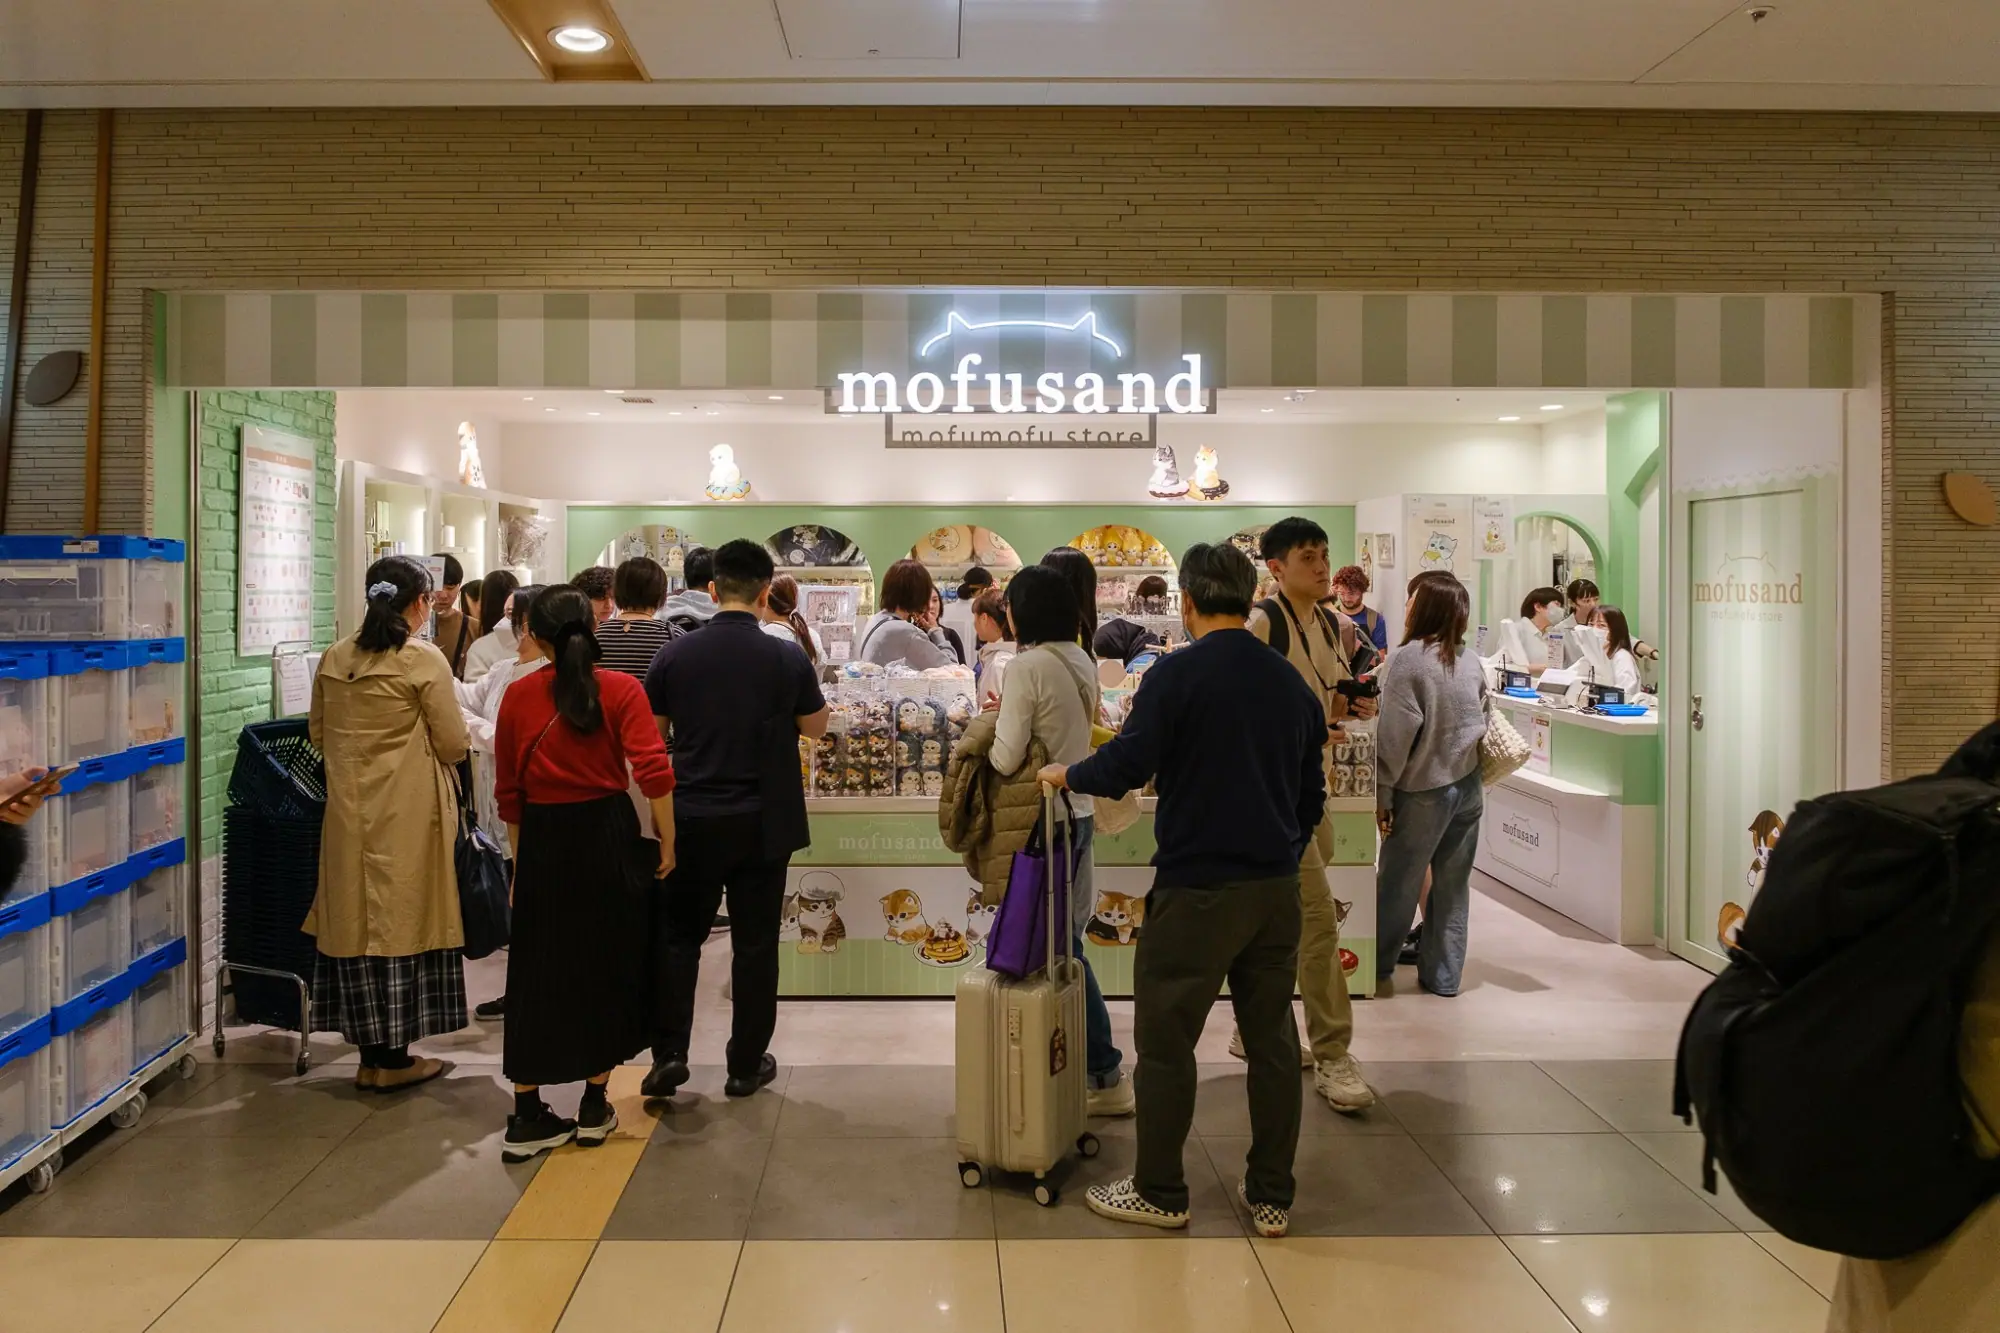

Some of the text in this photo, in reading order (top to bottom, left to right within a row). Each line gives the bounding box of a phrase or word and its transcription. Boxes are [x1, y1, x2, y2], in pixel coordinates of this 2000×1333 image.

[837, 353, 1207, 415] mofusand
[901, 425, 1144, 445] mofumofu store
[1694, 573, 1804, 604] mofusand
[1502, 822, 1539, 847] mofusand
